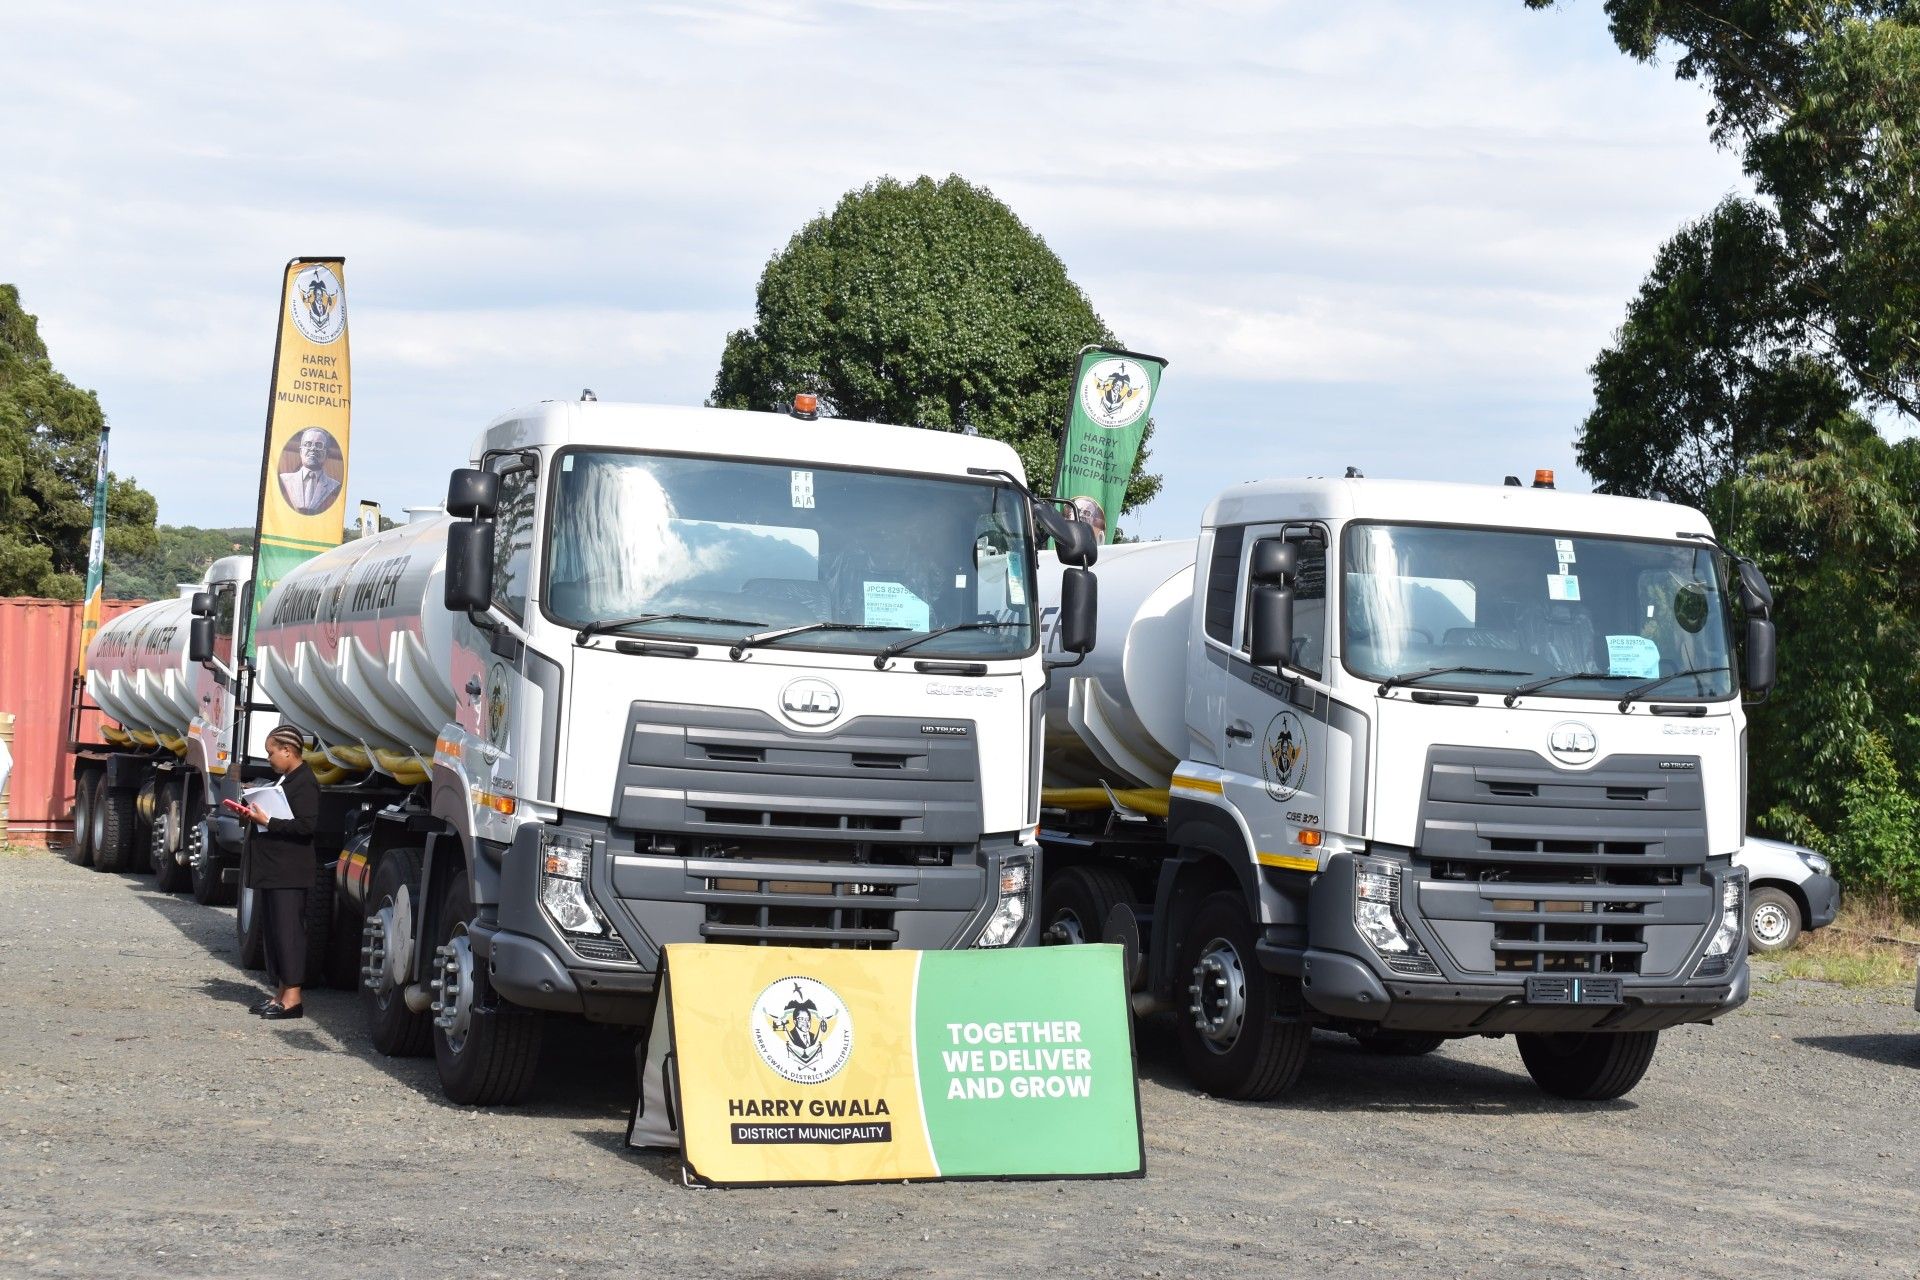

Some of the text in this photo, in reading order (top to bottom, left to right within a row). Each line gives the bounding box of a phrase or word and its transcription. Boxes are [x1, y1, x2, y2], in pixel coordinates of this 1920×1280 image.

[302, 354, 337, 367] HARRY
[300, 367, 338, 380] GWALA
[293, 379, 343, 394] DISTRICT
[277, 391, 351, 411] MUNICIPALITY
[1083, 432, 1118, 448] HARRY
[1080, 443, 1114, 459] GWALA
[1072, 454, 1117, 472] DISTRICT
[272, 555, 412, 626] DRINKING WATER
[145, 626, 177, 656] WATER
[935, 727, 967, 735] TRUCKS
[1302, 813, 1319, 824] 370
[946, 1021, 1082, 1045] TOGETHER
[754, 1028, 850, 1081] HARRY GWALA DISTRICT MUNICIPALITY
[942, 1049, 1092, 1072] WE DELIVER
[947, 1075, 1092, 1100] AND GROW
[728, 1098, 890, 1117] HARRY GWALA
[738, 1126, 884, 1140] DISTRICT MUNICIPALITY
